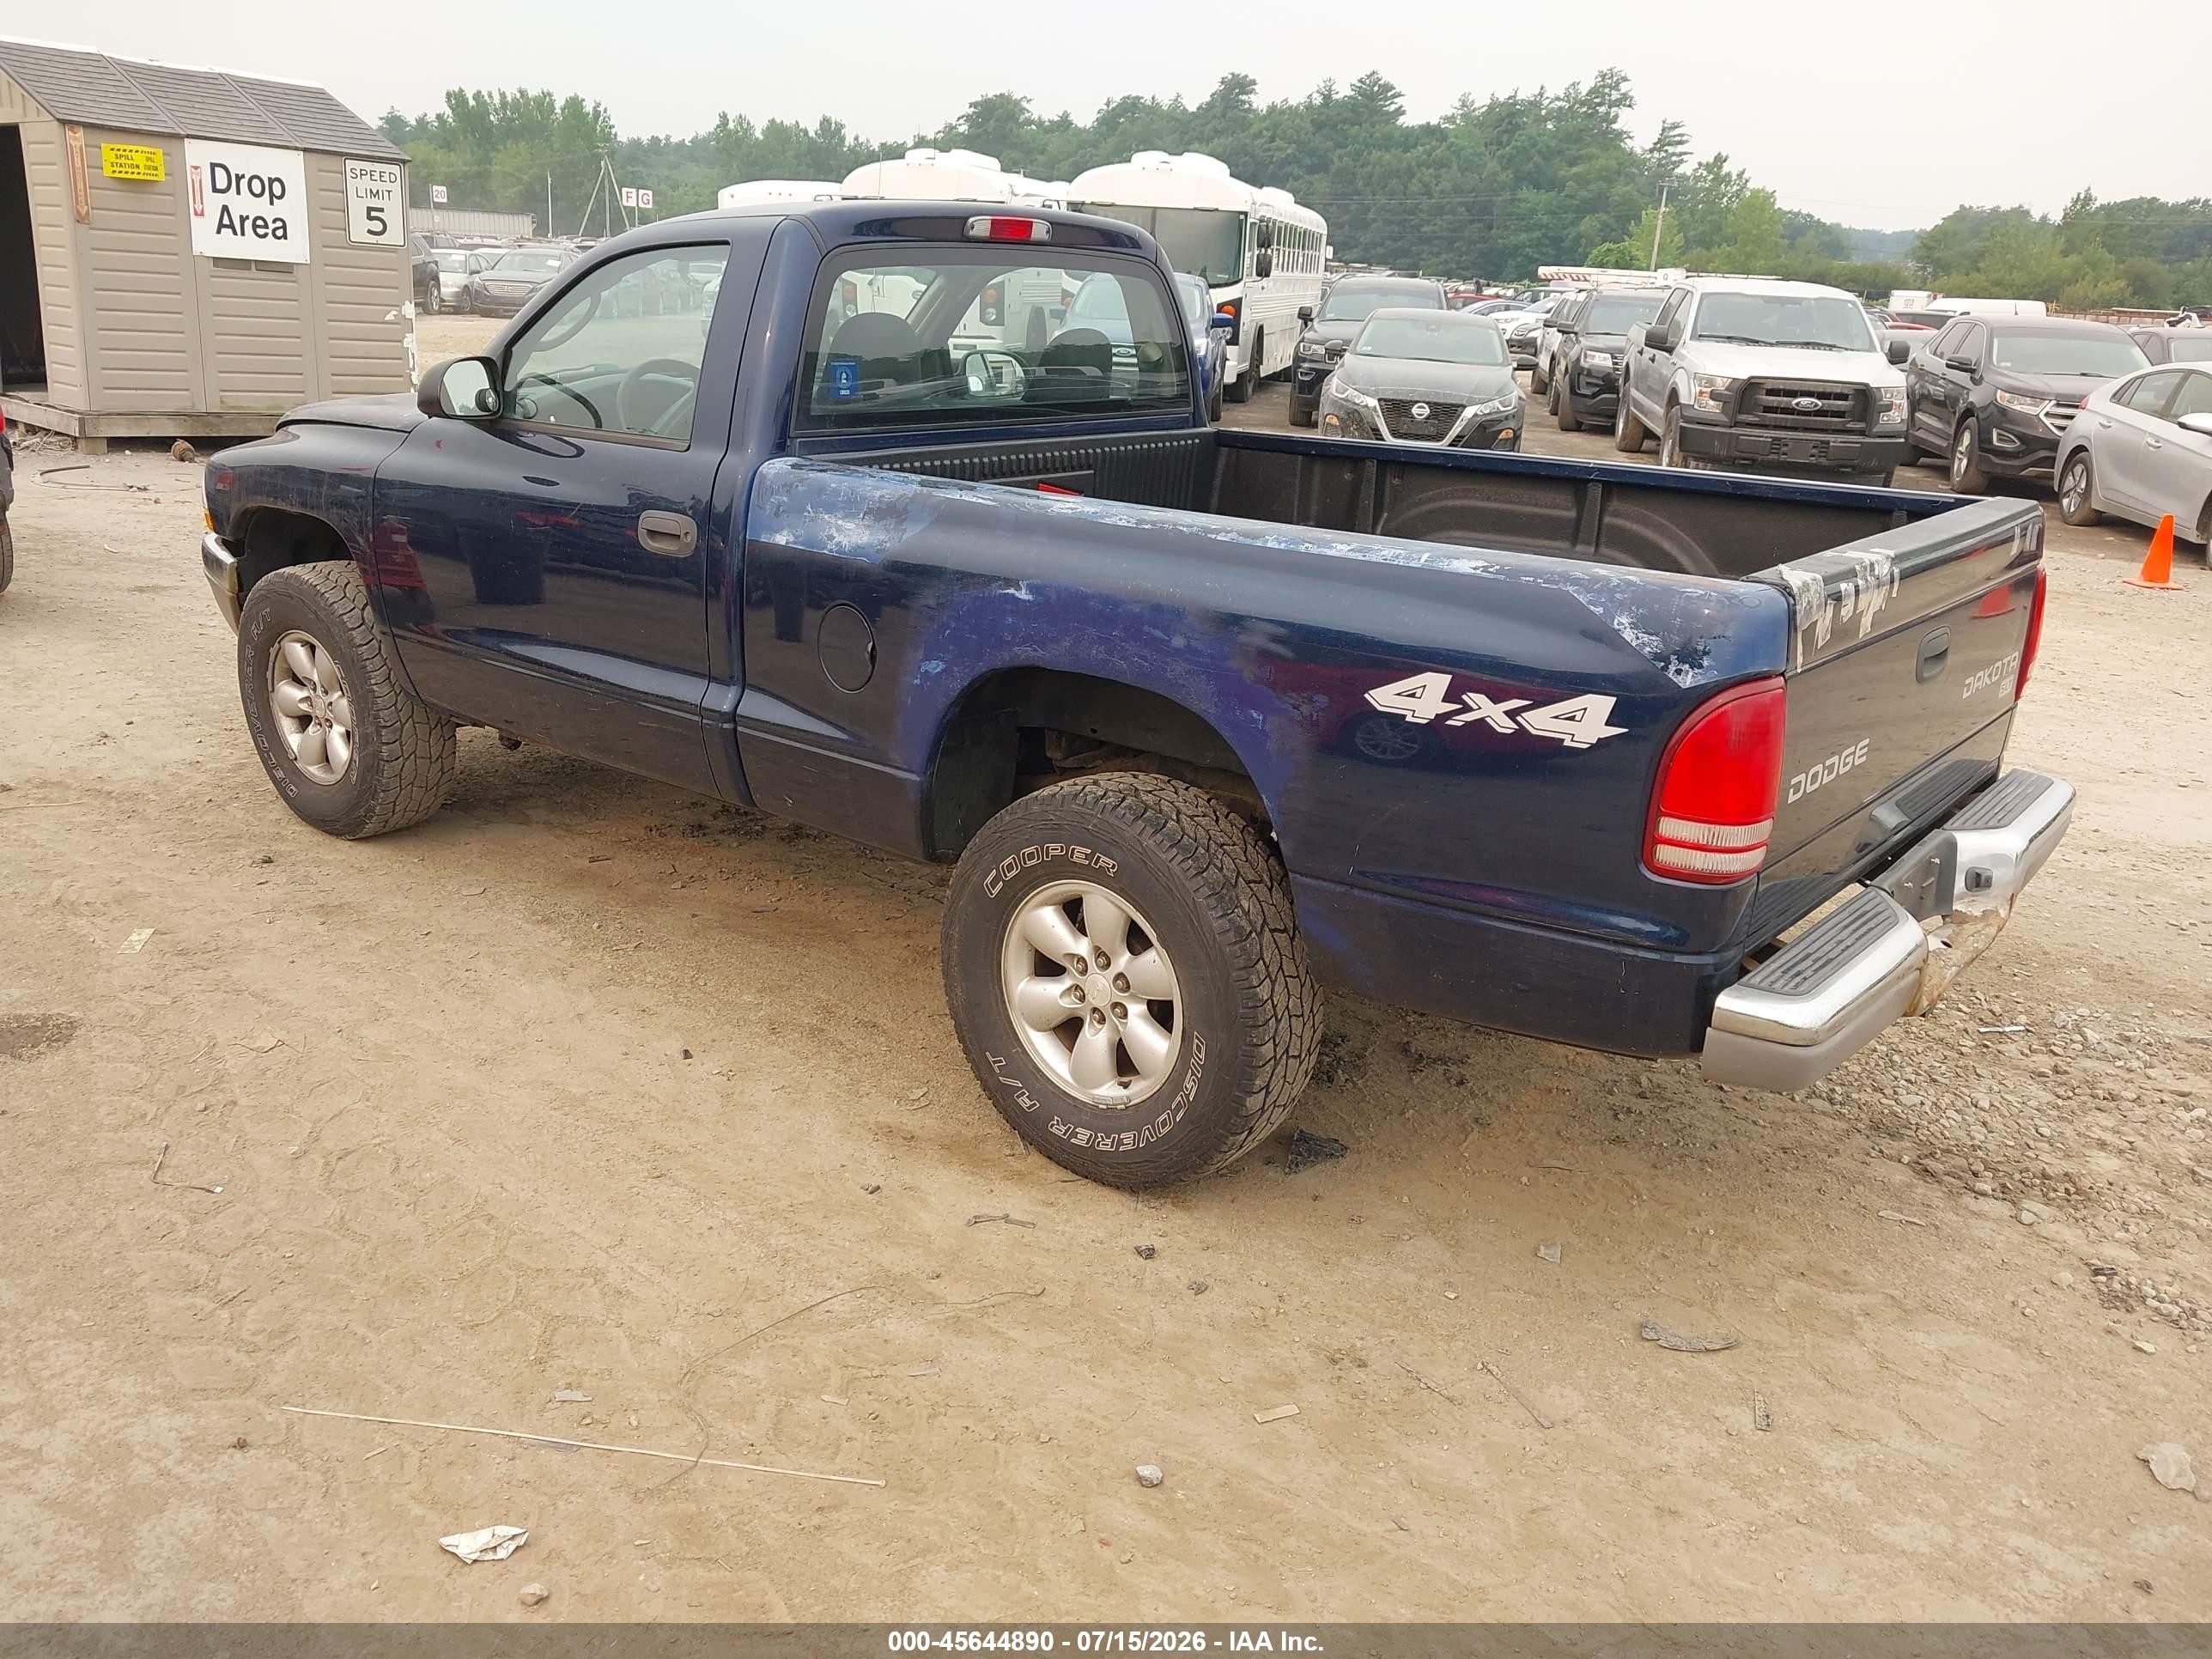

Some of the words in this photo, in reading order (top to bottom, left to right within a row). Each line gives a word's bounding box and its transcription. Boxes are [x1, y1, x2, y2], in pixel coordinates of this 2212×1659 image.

[110, 161, 140, 170] STATION
[349, 167, 398, 184] SPEED
[210, 161, 286, 206] Drop
[356, 186, 393, 201] LIMIT
[434, 189, 446, 199] 20
[626, 191, 633, 204] F
[641, 192, 650, 205] G
[216, 204, 289, 240] Area
[366, 205, 388, 237] 5
[1962, 651, 2020, 700] DAKOTA
[1787, 738, 1870, 805] DODGE
[983, 843, 1118, 899] COOPER
[985, 1050, 1041, 1113] A/T
[1048, 1030, 1206, 1152] DISCOVERER
